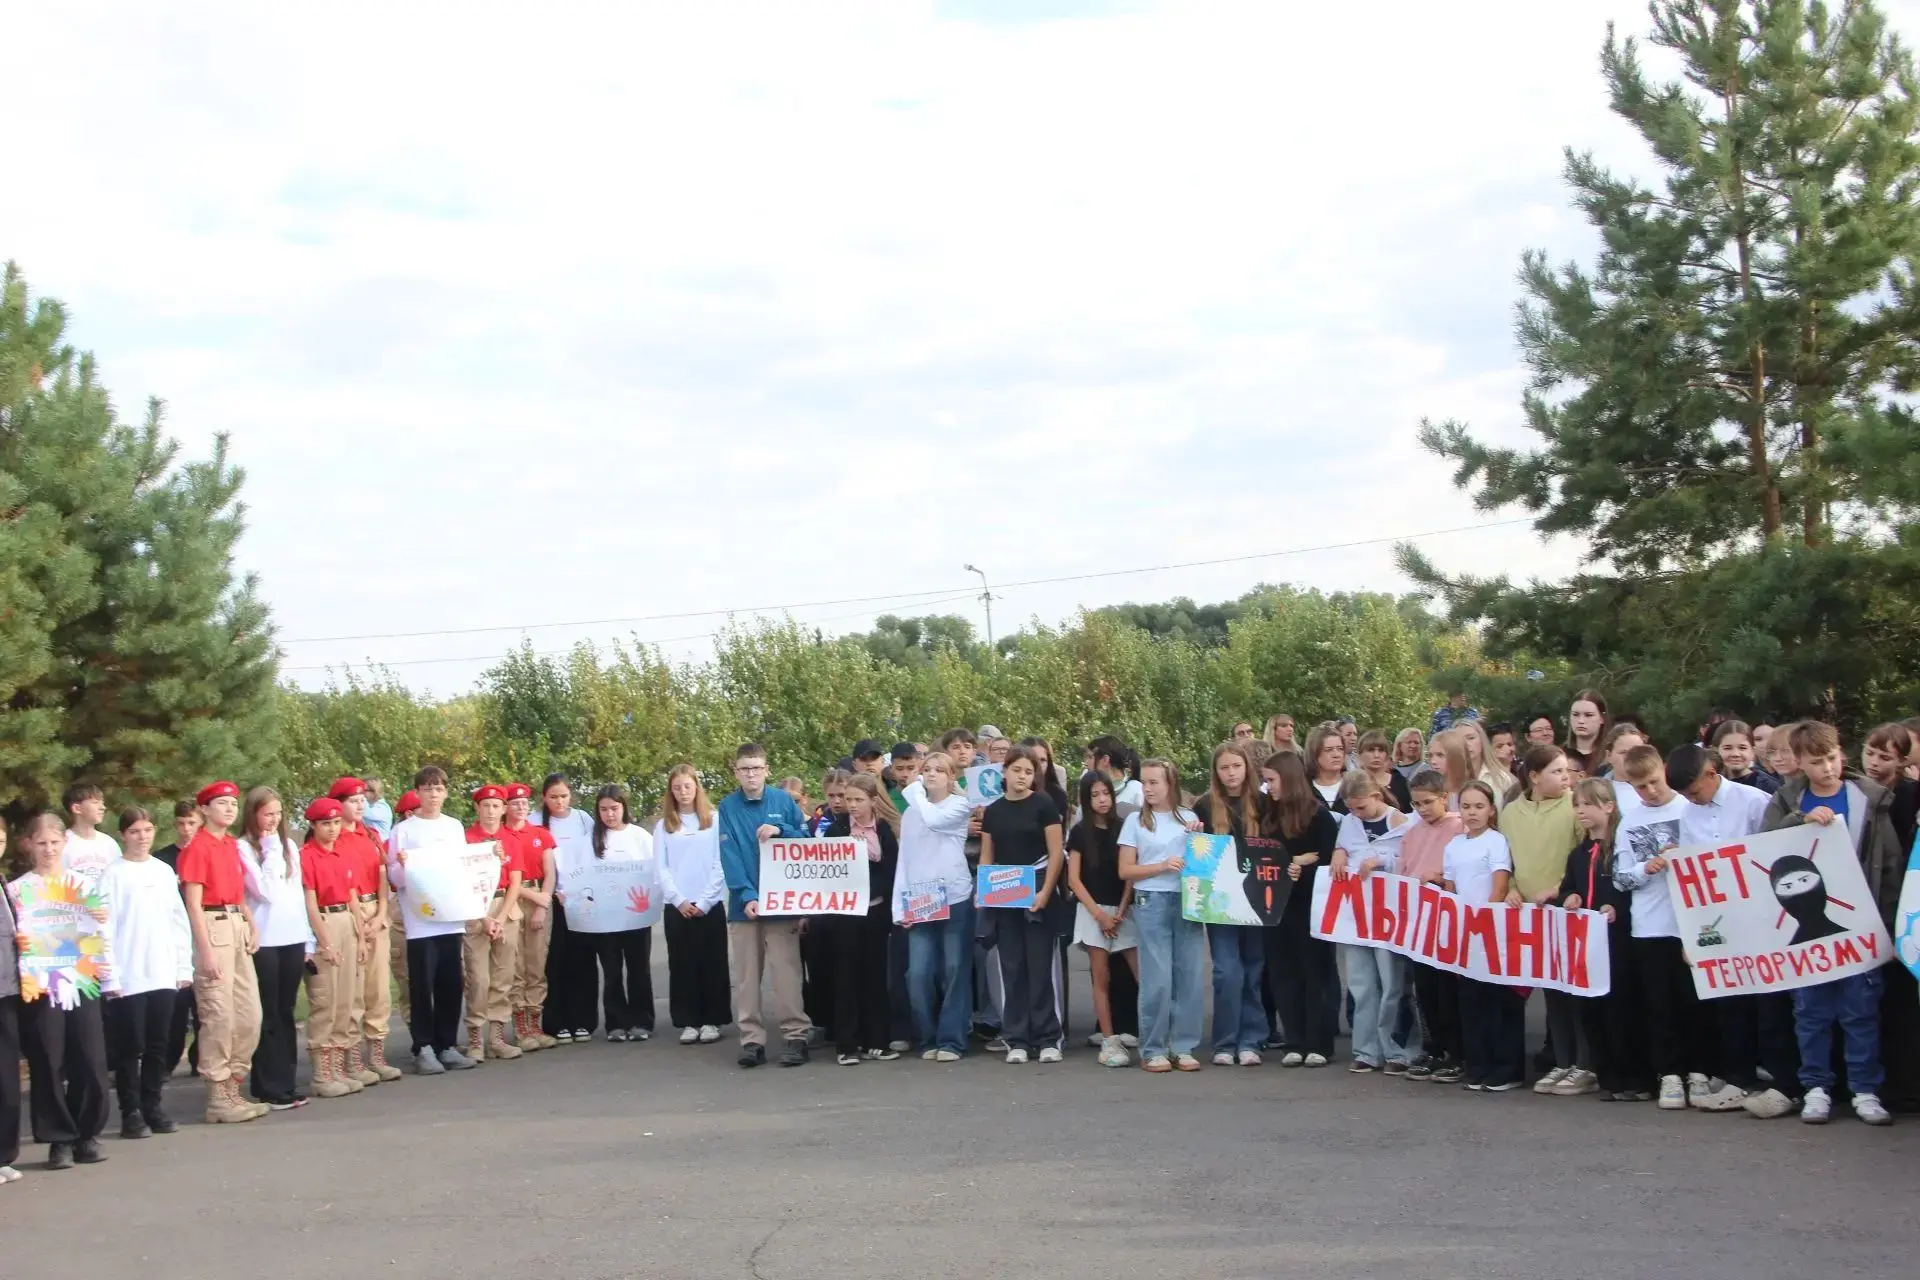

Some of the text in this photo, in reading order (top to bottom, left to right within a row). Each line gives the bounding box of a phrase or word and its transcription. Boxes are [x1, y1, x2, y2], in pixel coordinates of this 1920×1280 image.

[772, 842, 856, 861] ПОМНИМ
[784, 863, 849, 880] 03.09.2004
[1256, 865, 1281, 881] НЕТ
[1671, 844, 1750, 909] НЕТ
[992, 879, 1021, 892] ПРОТИВ
[766, 890, 858, 911] БЕСЛАН
[1697, 932, 1879, 990] ТЕРРОРИЗМУ
